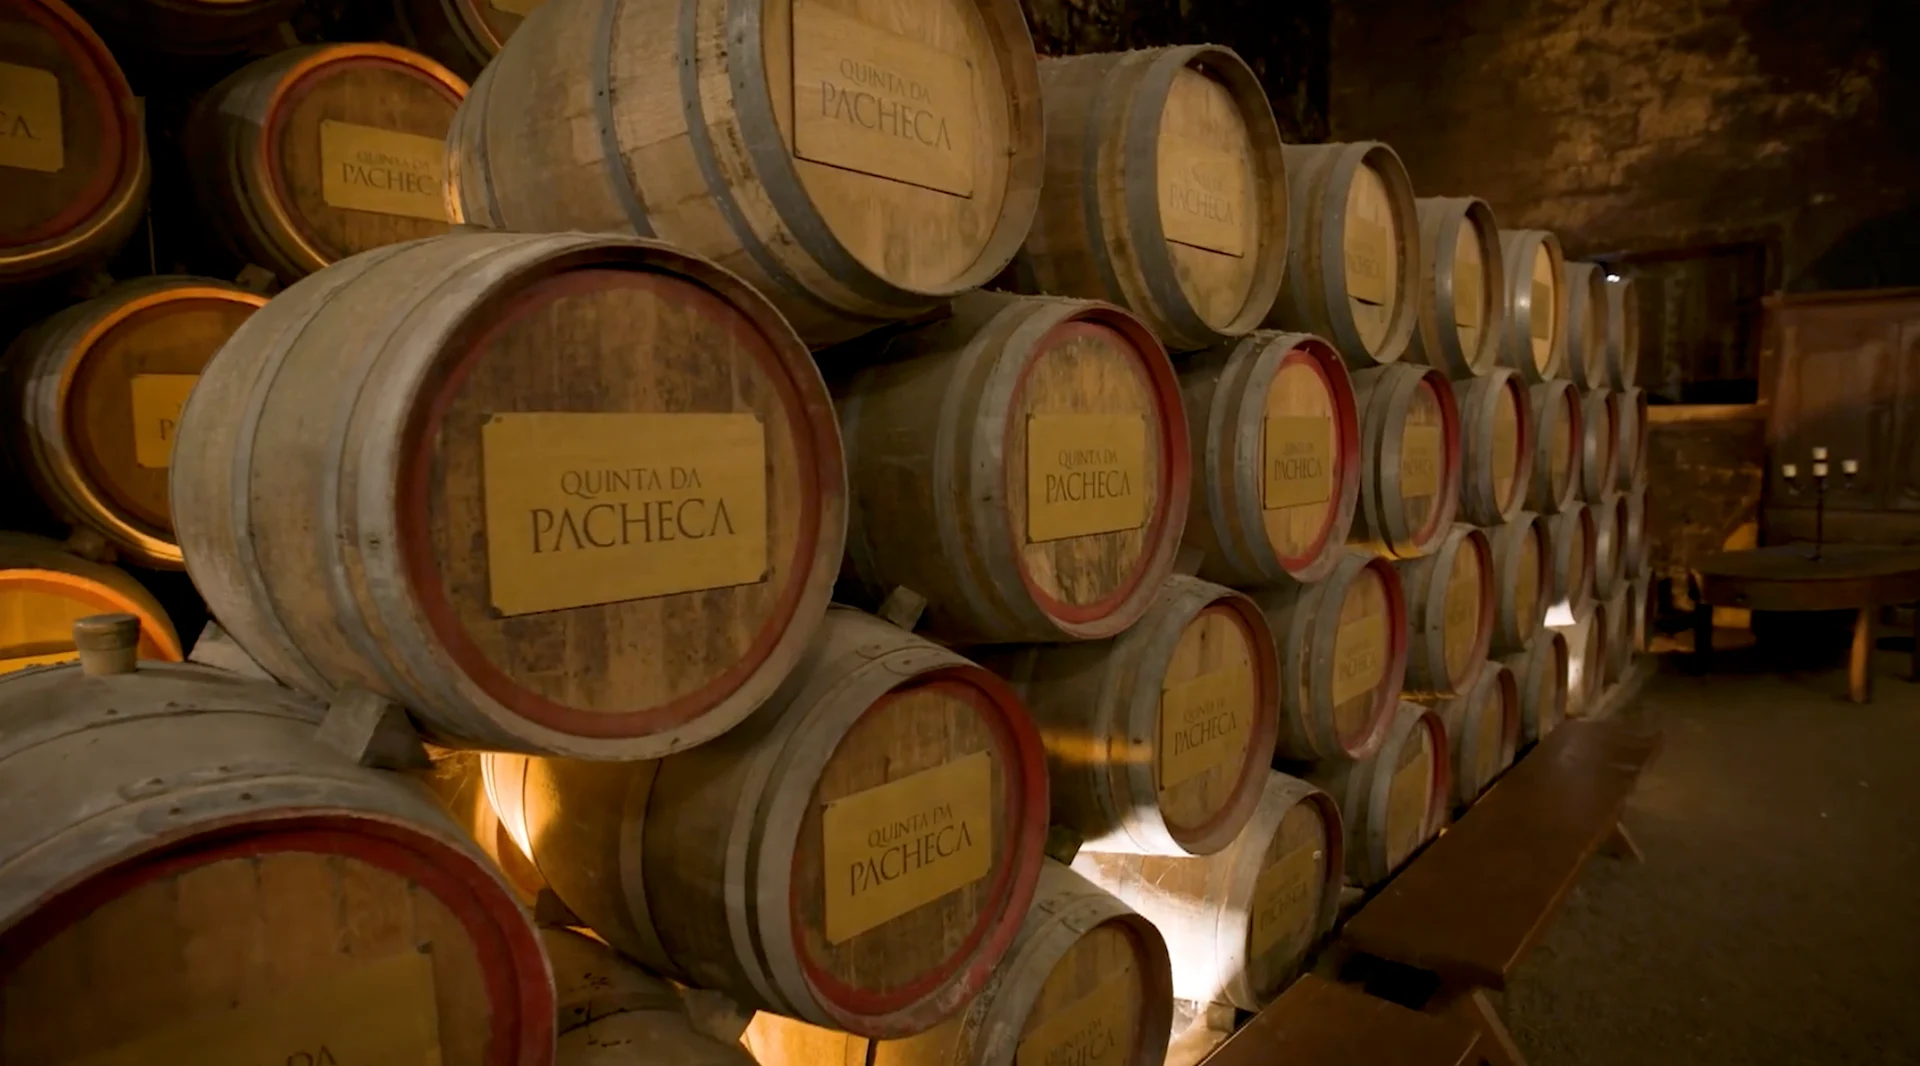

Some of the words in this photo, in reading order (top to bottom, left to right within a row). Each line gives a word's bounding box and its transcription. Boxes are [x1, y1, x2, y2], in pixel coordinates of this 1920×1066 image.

[840, 58, 905, 97] QUINTA
[910, 81, 931, 104] DA
[821, 79, 951, 150] PACHECA
[561, 467, 662, 499] QUINTA
[670, 466, 702, 490] DA
[1058, 449, 1102, 470] QUINTA
[1045, 468, 1131, 504] PACHECA
[530, 497, 736, 554] PACHECA
[1175, 709, 1236, 756] PACHECA
[868, 812, 929, 848] QUINTA
[851, 820, 973, 896] PACHECA
